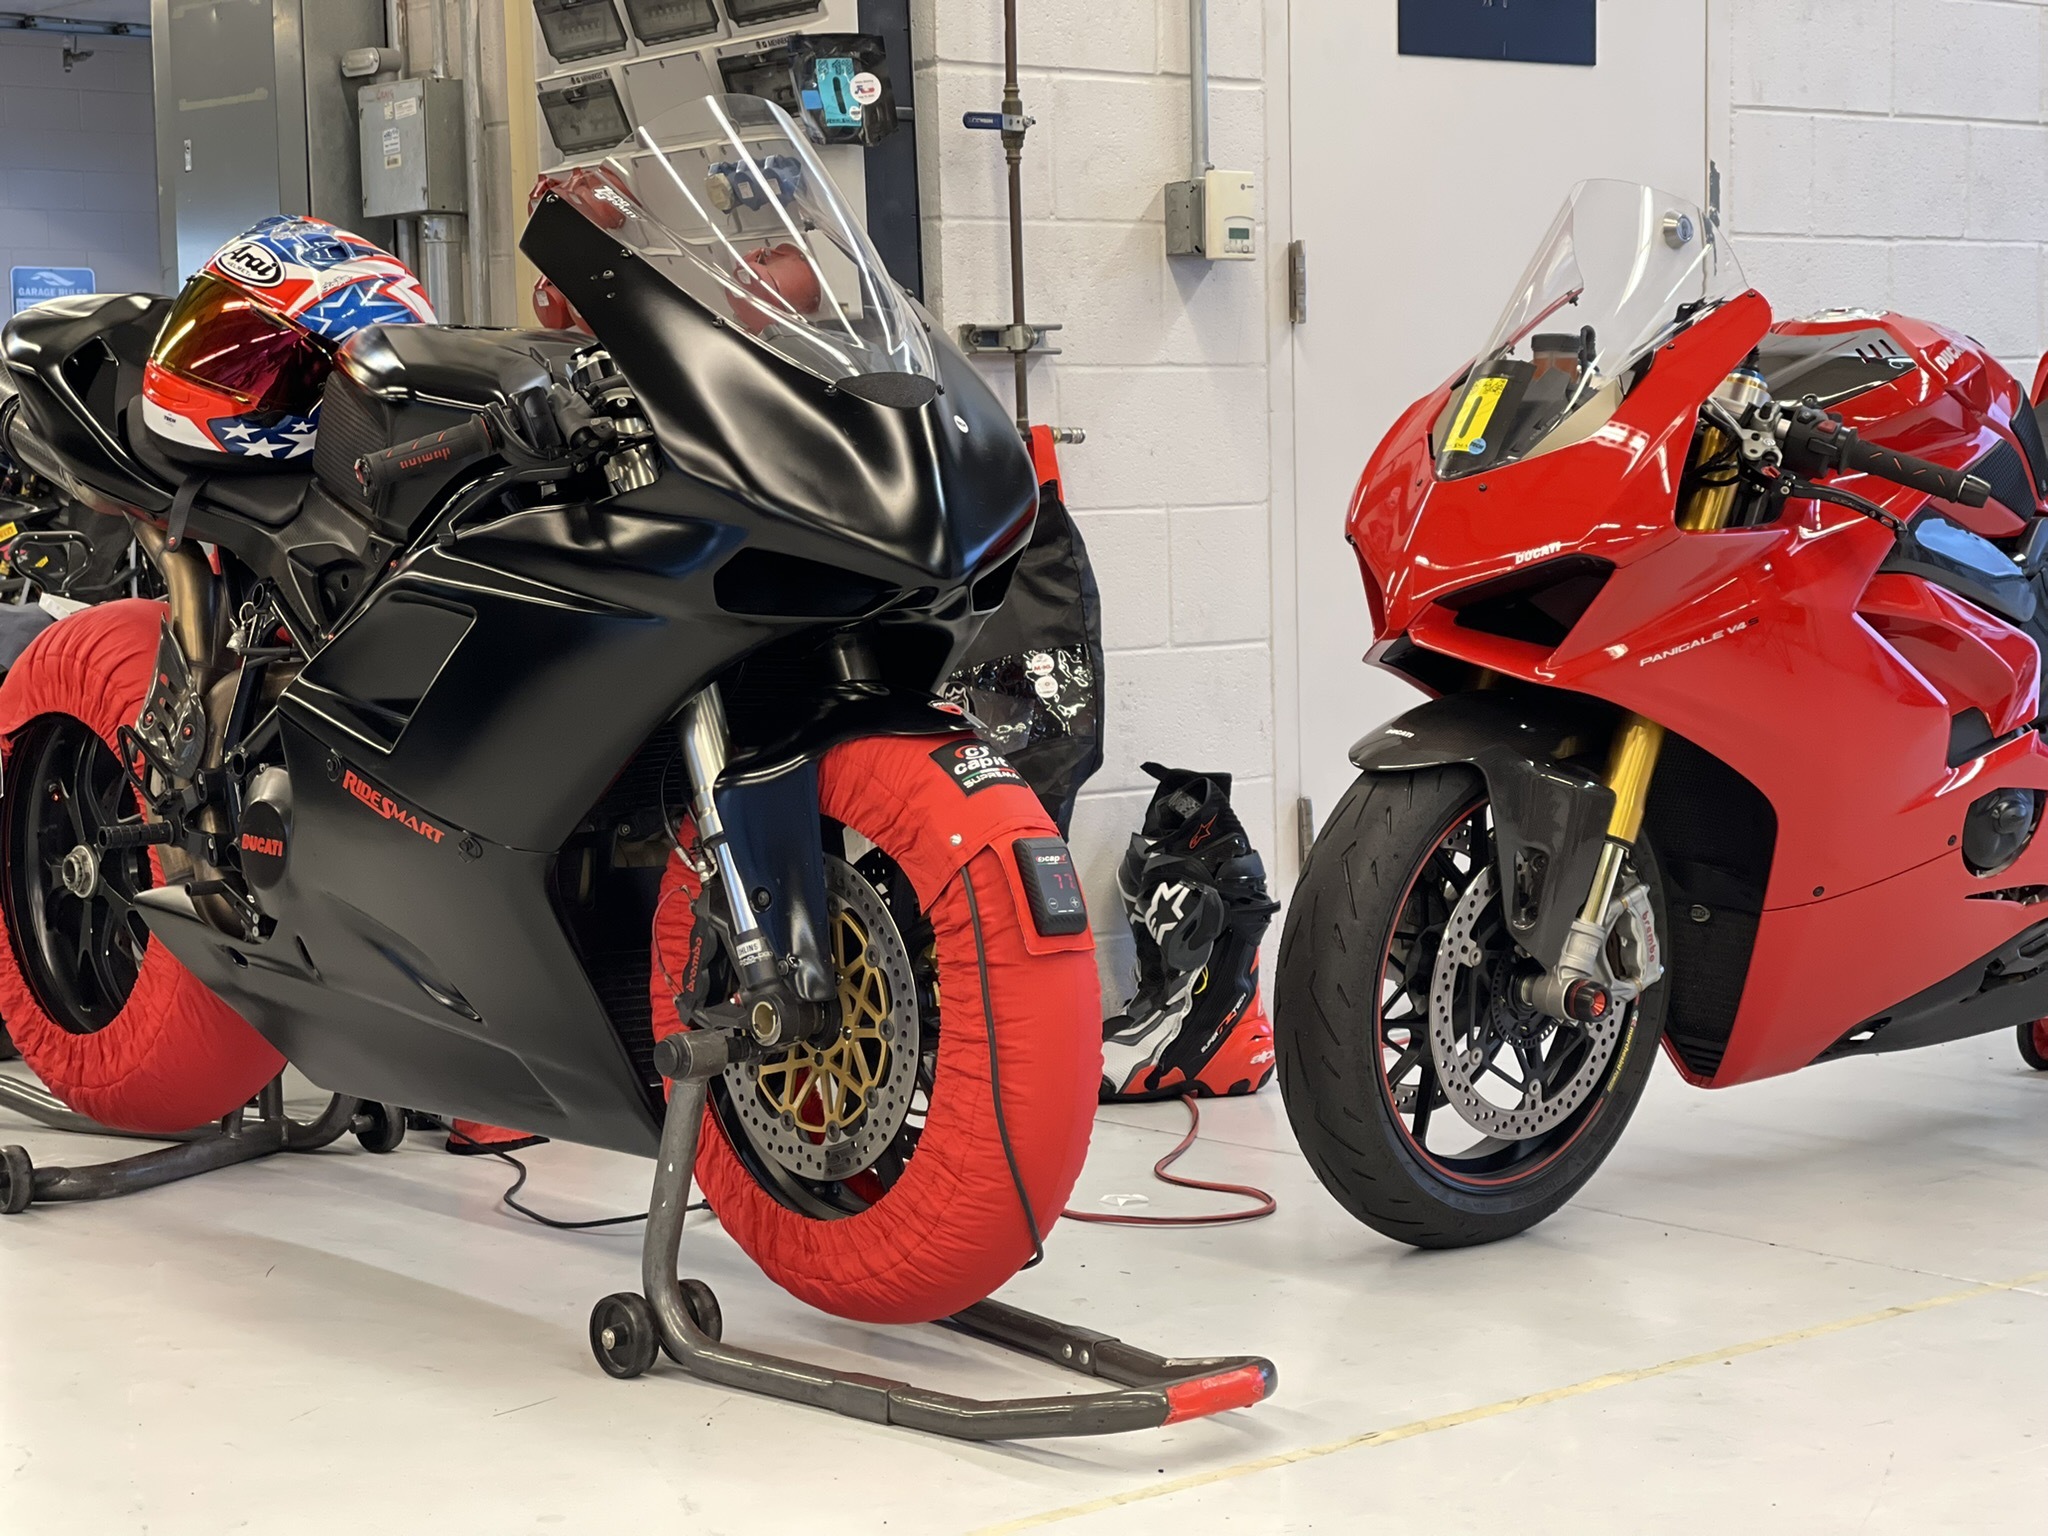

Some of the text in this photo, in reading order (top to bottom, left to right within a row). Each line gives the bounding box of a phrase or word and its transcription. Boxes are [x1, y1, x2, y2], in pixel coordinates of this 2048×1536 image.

[224, 245, 278, 276] Arai
[18, 287, 55, 297] GARAGE
[1515, 541, 1561, 564] DUCATI
[1639, 629, 1725, 667] PANIGALE
[954, 757, 1009, 775] capit
[963, 771, 1020, 789] SUPREMA
[241, 833, 283, 857] DUCATI
[1052, 873, 1075, 890] 77
[1641, 910, 1655, 963] brembo
[738, 943, 759, 954] HLINS
[685, 936, 703, 993] brembo
